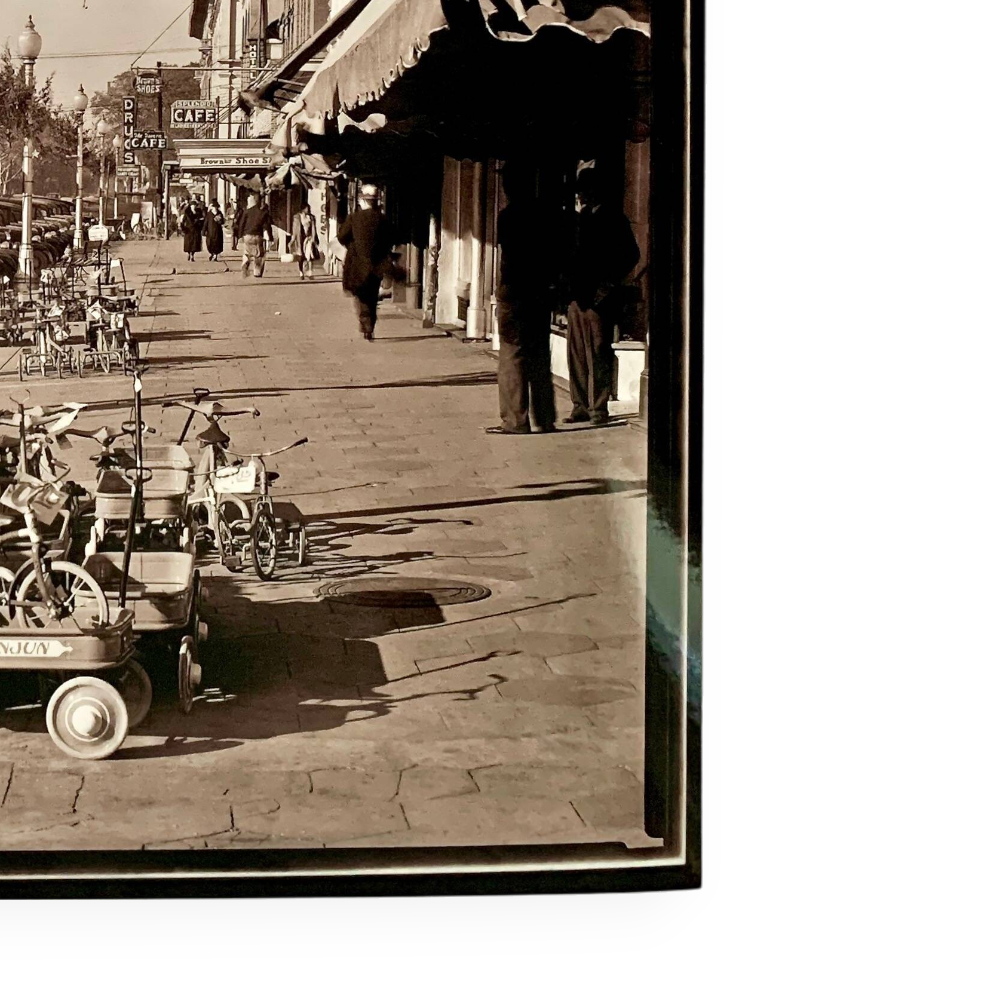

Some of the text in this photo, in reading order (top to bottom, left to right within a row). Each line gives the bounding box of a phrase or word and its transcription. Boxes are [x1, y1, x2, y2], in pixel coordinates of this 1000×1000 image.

[136, 85, 160, 93] SHOES
[174, 109, 215, 122] CAFE
[131, 138, 166, 148] CAFE
[235, 156, 260, 165] Shoe
